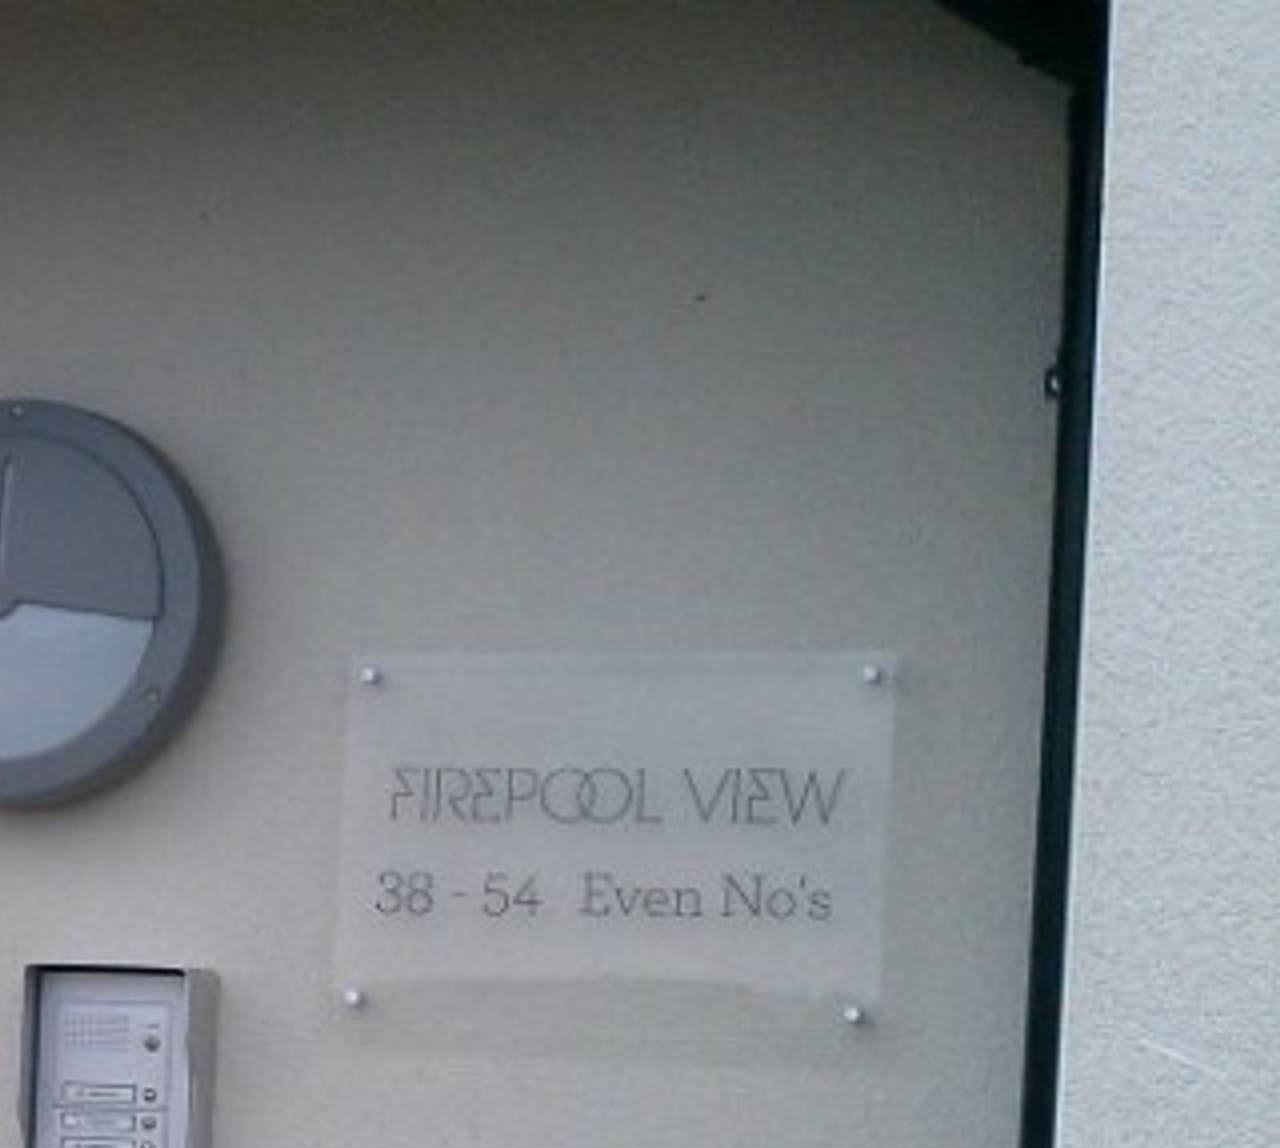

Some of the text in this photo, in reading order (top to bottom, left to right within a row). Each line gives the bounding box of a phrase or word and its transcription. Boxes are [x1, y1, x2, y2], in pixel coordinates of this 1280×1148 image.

[389, 767, 848, 825] FIREPOOL VIEW
[374, 871, 435, 915] 38
[482, 874, 545, 917] 54
[578, 872, 703, 918] Even
[721, 876, 833, 920] No's
